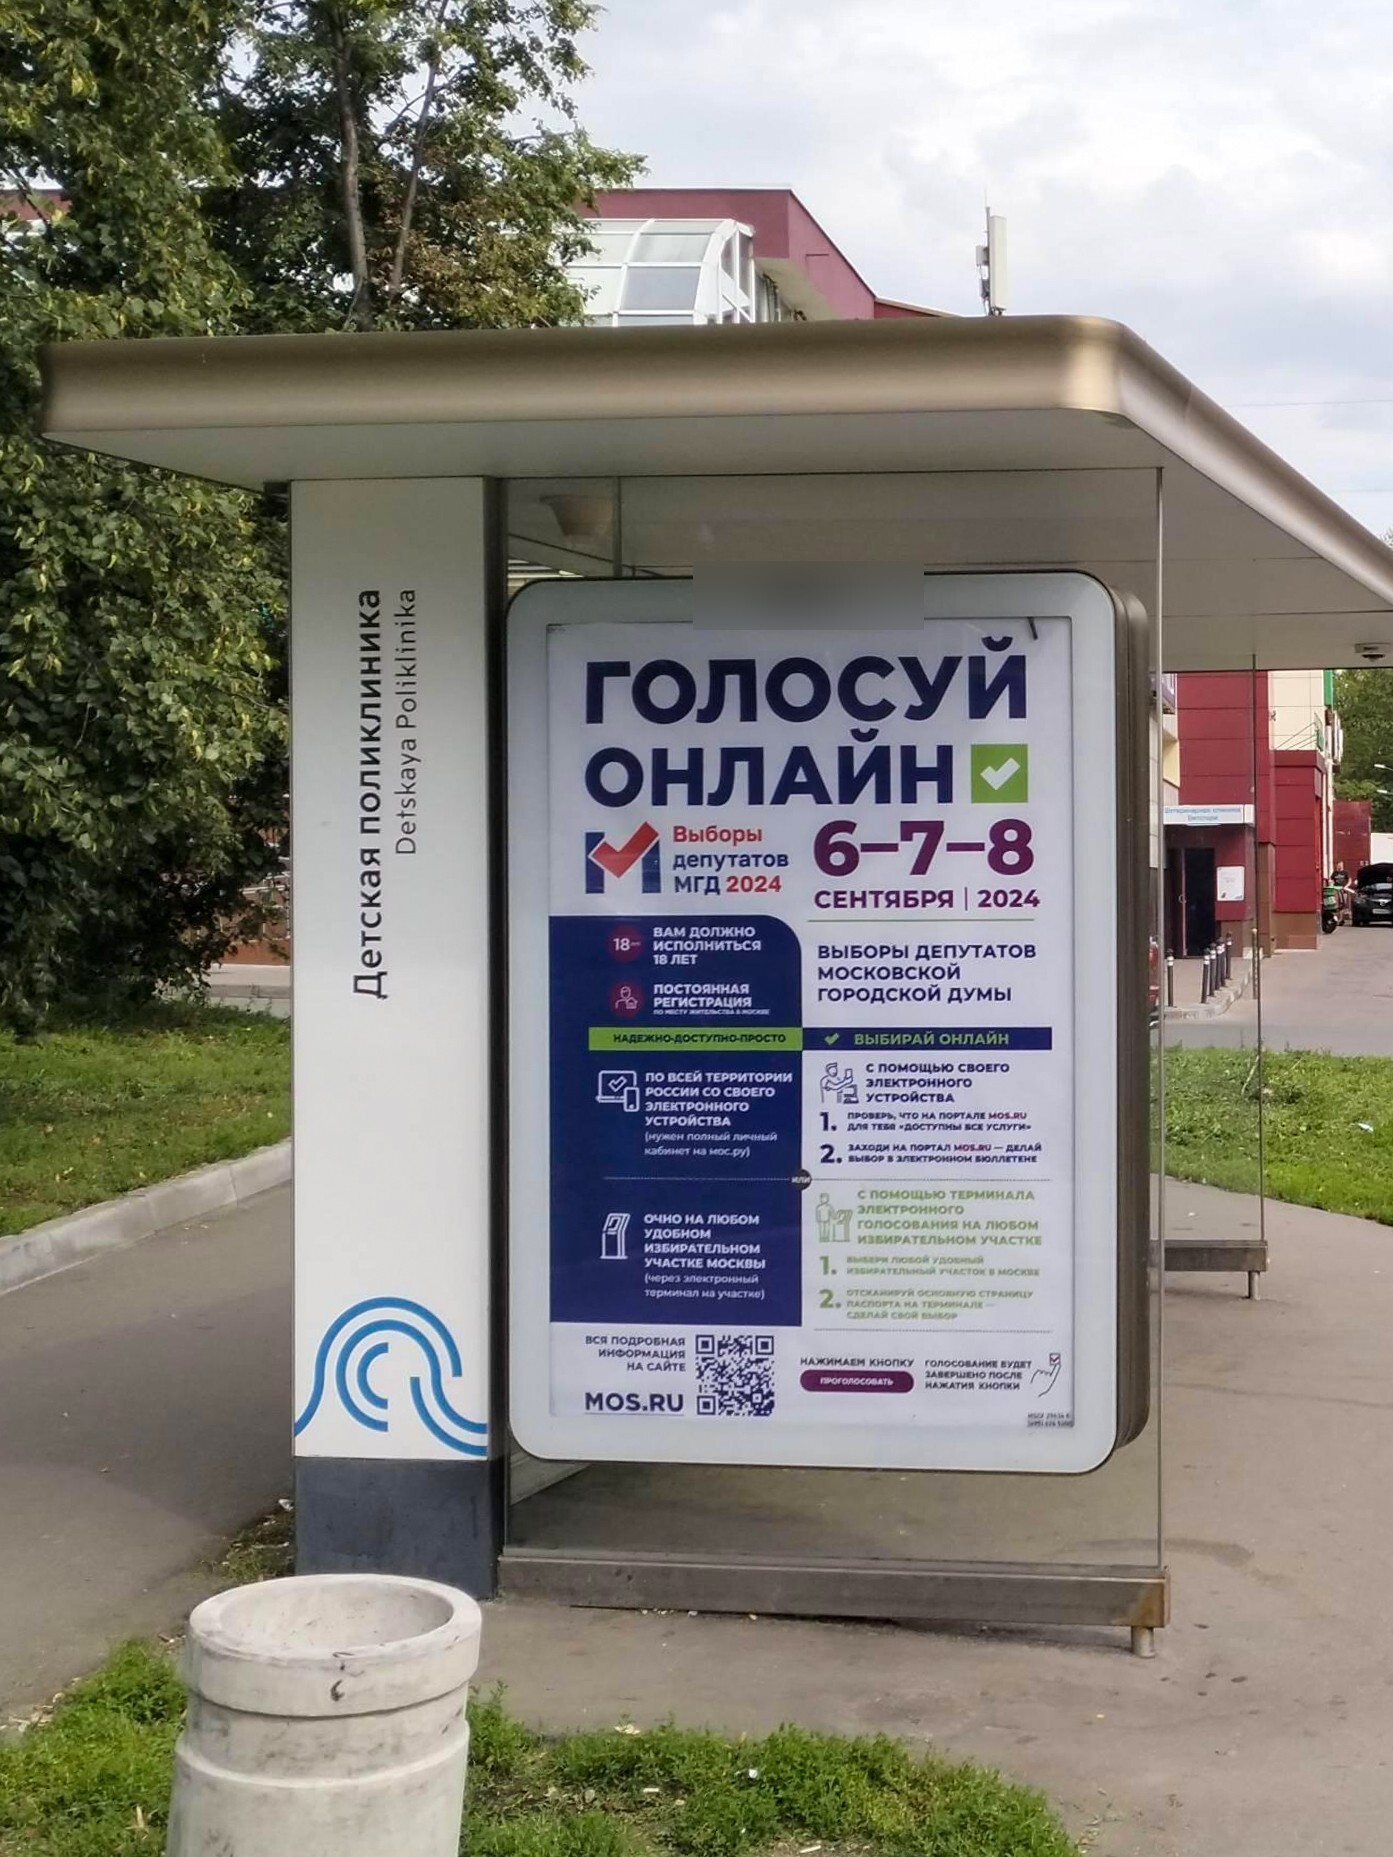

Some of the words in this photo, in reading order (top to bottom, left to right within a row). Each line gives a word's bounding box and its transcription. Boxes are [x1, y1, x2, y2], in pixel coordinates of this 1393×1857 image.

[394, 589, 417, 728] Poliklinika
[585, 635, 1026, 724] ГОЛОСУЙ
[358, 590, 381, 834] поликлиника
[585, 727, 954, 807] ОНЛАЙН
[394, 739, 421, 854] Detskaya
[673, 825, 763, 846] Выборы
[673, 852, 789, 870] депутатов
[674, 876, 721, 895] МГД
[726, 875, 782, 893] 2024
[814, 889, 953, 909] СЕНТЯБРЯ
[977, 888, 1040, 908] 2024
[353, 847, 387, 999] Детская
[653, 927, 685, 937] ВАМ
[689, 927, 756, 938] ДОЛЖНО
[614, 938, 630, 951] 18
[653, 940, 762, 951] ИСПОЛНИТЬСЯ
[818, 945, 908, 959] ВЫБОРЫ
[915, 945, 1036, 960] ДЕПУТАТОВ
[654, 954, 668, 964] 18
[670, 954, 697, 964] ЛЕТ
[818, 963, 960, 980] МОСКОВСКОЙ
[653, 984, 749, 995] ПОСТОЯННАЯ
[818, 985, 941, 1003] ГОРОДСКОЙ
[948, 987, 1011, 1003] ДУМЫ
[653, 997, 752, 1009] РЕГИСТРАЦИЯ
[614, 1034, 786, 1044] НАДЕЖНО-ДОСТУПНО-ПРОСТО
[855, 1031, 935, 1045] ВЫБИРАЙ
[940, 1031, 1009, 1044] ОНЛАЙН
[866, 1064, 875, 1072] С
[878, 1064, 954, 1074] ПОМОЩЬЮ
[958, 1064, 1010, 1072] СВОЕГО
[645, 1072, 665, 1083] ПО
[668, 1070, 702, 1083] ВСЕЙ
[705, 1072, 793, 1083] ТЕРРИТОРИИ
[866, 1079, 972, 1088] ЭЛЕКТРОННОГО
[645, 1087, 699, 1097] РОССИИ
[702, 1087, 720, 1097] СО
[724, 1087, 775, 1097] СВОЕГО
[866, 1092, 954, 1103] УСТРОЙСТВА
[645, 1101, 749, 1112] ЭЛЕКТРОННОГО
[645, 1114, 731, 1127] УСТРОЙСТВА
[820, 1112, 837, 1131] 1.
[939, 1112, 986, 1120] ПОРТАЛЕ
[645, 1132, 684, 1142] (нужен
[687, 1131, 730, 1141] полный
[733, 1131, 777, 1141] личный
[645, 1146, 690, 1156] кабинет
[693, 1148, 707, 1156] на
[820, 1144, 842, 1163] 2.
[1006, 1143, 1042, 1153] ДЕЛАЙ
[896, 1155, 972, 1163] ЭЛЕКТРОННОМ
[858, 1191, 868, 1199] С
[871, 1190, 946, 1201] ПОМОЩЬЮ
[950, 1191, 1034, 1200] ТЕРМИНАЛА
[858, 1206, 964, 1214] ЭЛЕКТРОННОГО
[644, 1214, 682, 1224] ОЧНО
[685, 1215, 703, 1224] НА
[707, 1215, 759, 1225] ЛЮБОМ
[858, 1220, 958, 1230] ГОЛОСОВАНИЯ
[963, 1221, 981, 1230] НА
[986, 1221, 1039, 1230] ЛЮБОМ
[644, 1229, 711, 1240] УДОБНОМ
[858, 1235, 976, 1245] ИЗБИРАТЕЛЬНОМ
[981, 1236, 1042, 1245] УЧАСТКЕ
[644, 1244, 760, 1254] ИЗБИРАТЕЛЬНОМ
[645, 1259, 703, 1268] УЧАСТКЕ
[706, 1259, 765, 1269] МОСКВЫ
[820, 1256, 837, 1275] 1.
[645, 1274, 680, 1284] (через
[645, 1289, 699, 1299] терминал
[702, 1290, 715, 1298] на
[819, 1289, 842, 1308] 2.
[585, 1336, 607, 1344] ВСЯ
[611, 1336, 685, 1346] ПОДРОБНАЯ
[599, 1349, 685, 1360] ИНФОРМАЦИЯ
[627, 1363, 643, 1371] НА
[647, 1361, 686, 1372] САЙТЕ
[869, 1358, 914, 1367] КНОПКУ
[925, 1360, 998, 1368] ГОЛОСОВАНИЕ
[1001, 1360, 1032, 1369] БУДЕТ
[925, 1371, 986, 1379] ЗАВЕРШЕНО
[989, 1371, 1022, 1379] ПОСЛЕ
[820, 1377, 894, 1386] ПРОГОЛОСОВАТЬ
[925, 1382, 974, 1390] НАЖАТИЯ
[978, 1382, 1020, 1390] КНОПКИ
[585, 1392, 684, 1412] MOS.RU
